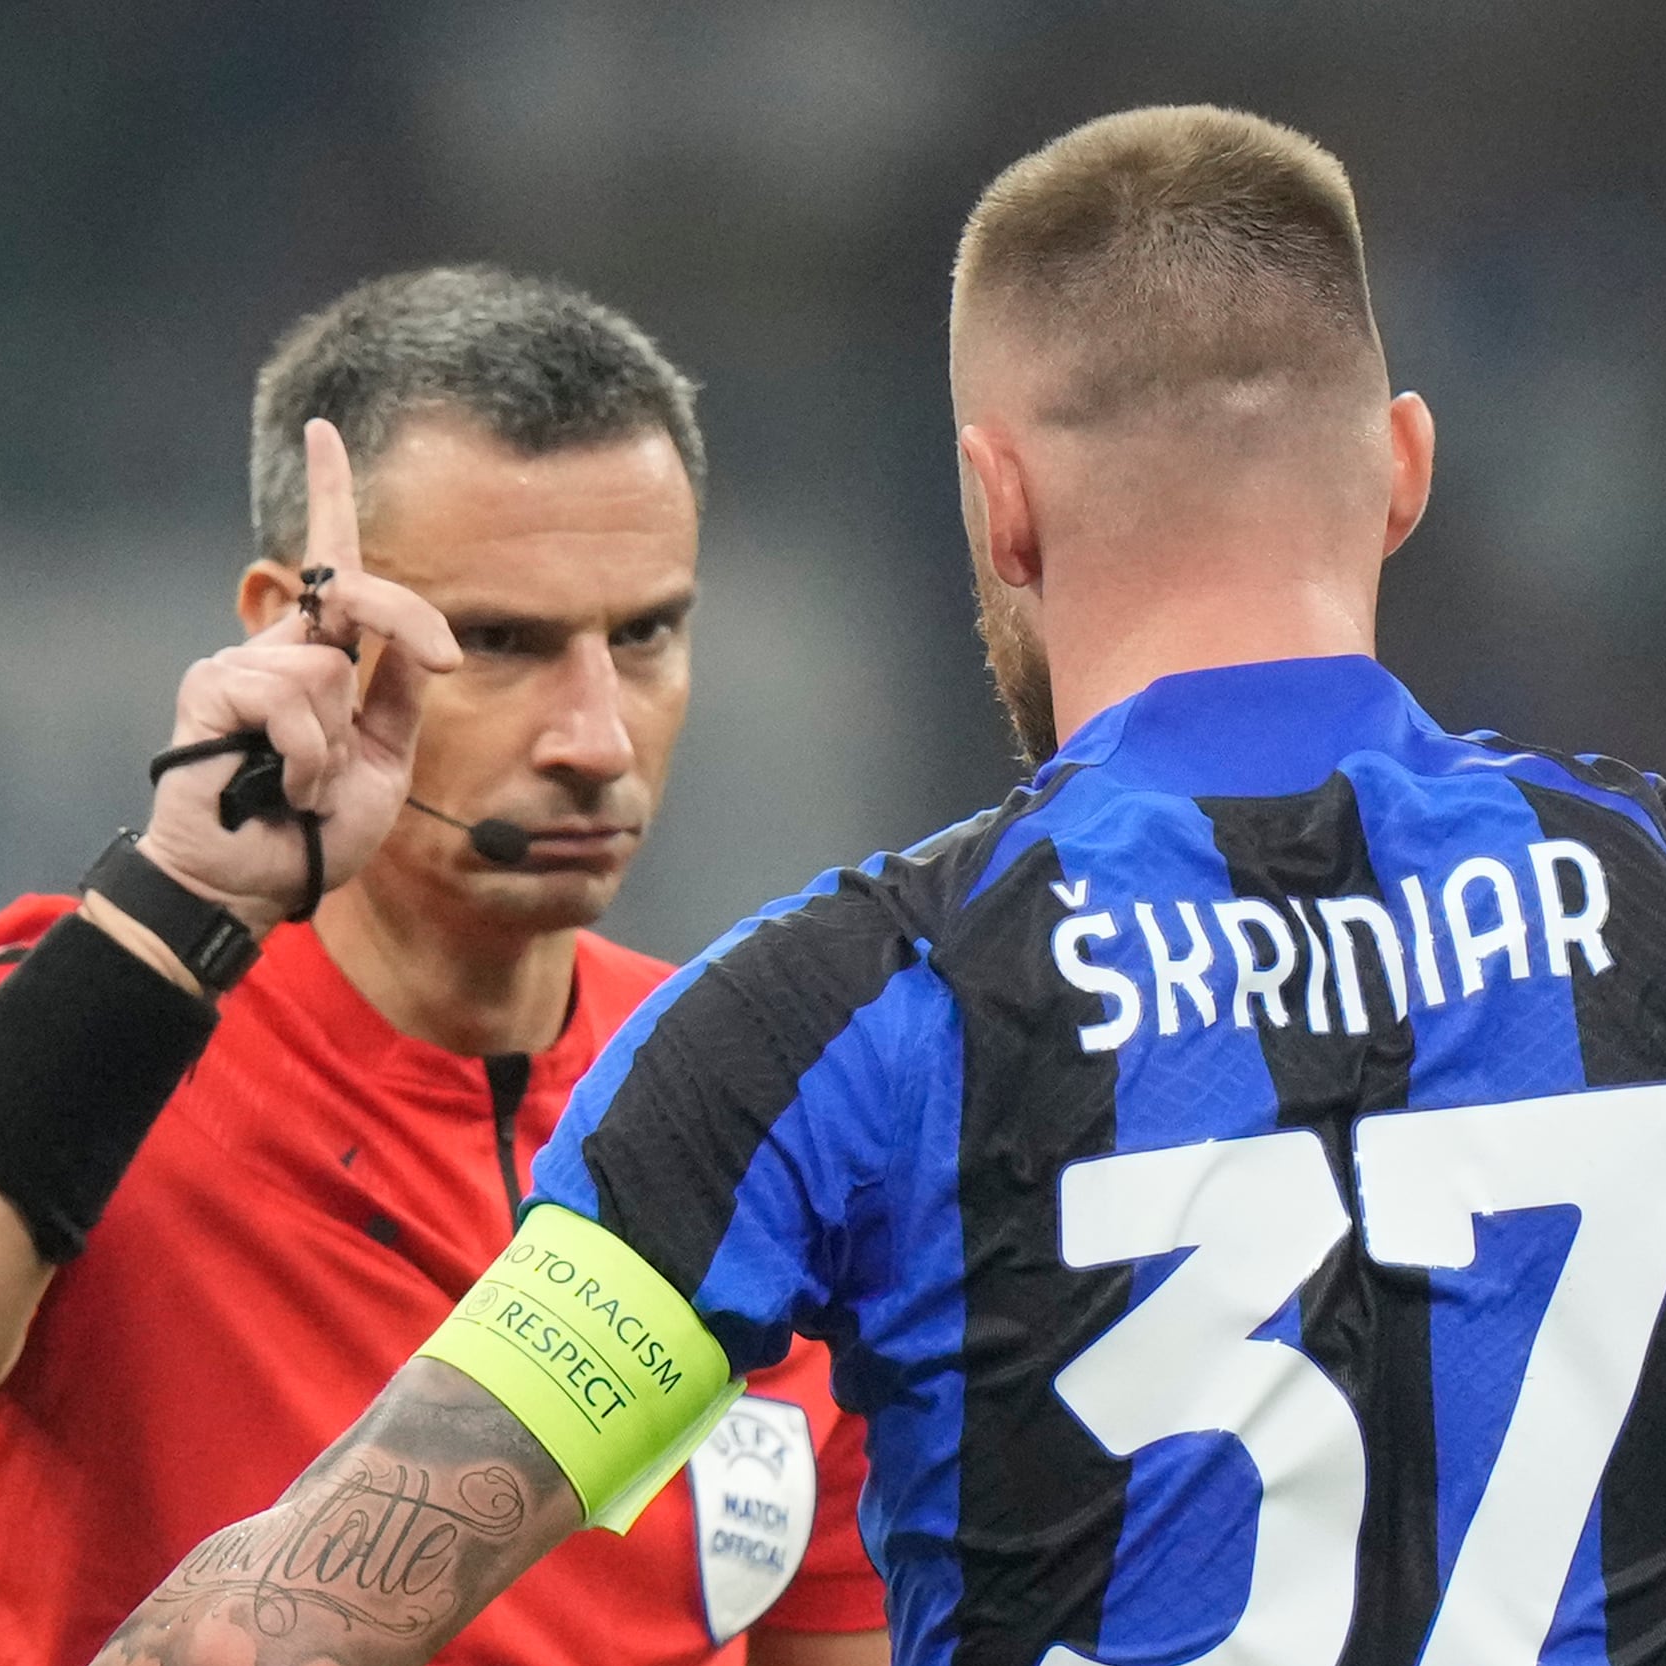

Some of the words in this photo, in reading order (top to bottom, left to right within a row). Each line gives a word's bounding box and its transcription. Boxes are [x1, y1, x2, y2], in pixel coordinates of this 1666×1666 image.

[1050, 839, 1616, 1053] ŠKRINIAR
[496, 1300, 627, 1419] RESPECT
[534, 1250, 576, 1284] TO
[574, 1278, 683, 1394] RACISM
